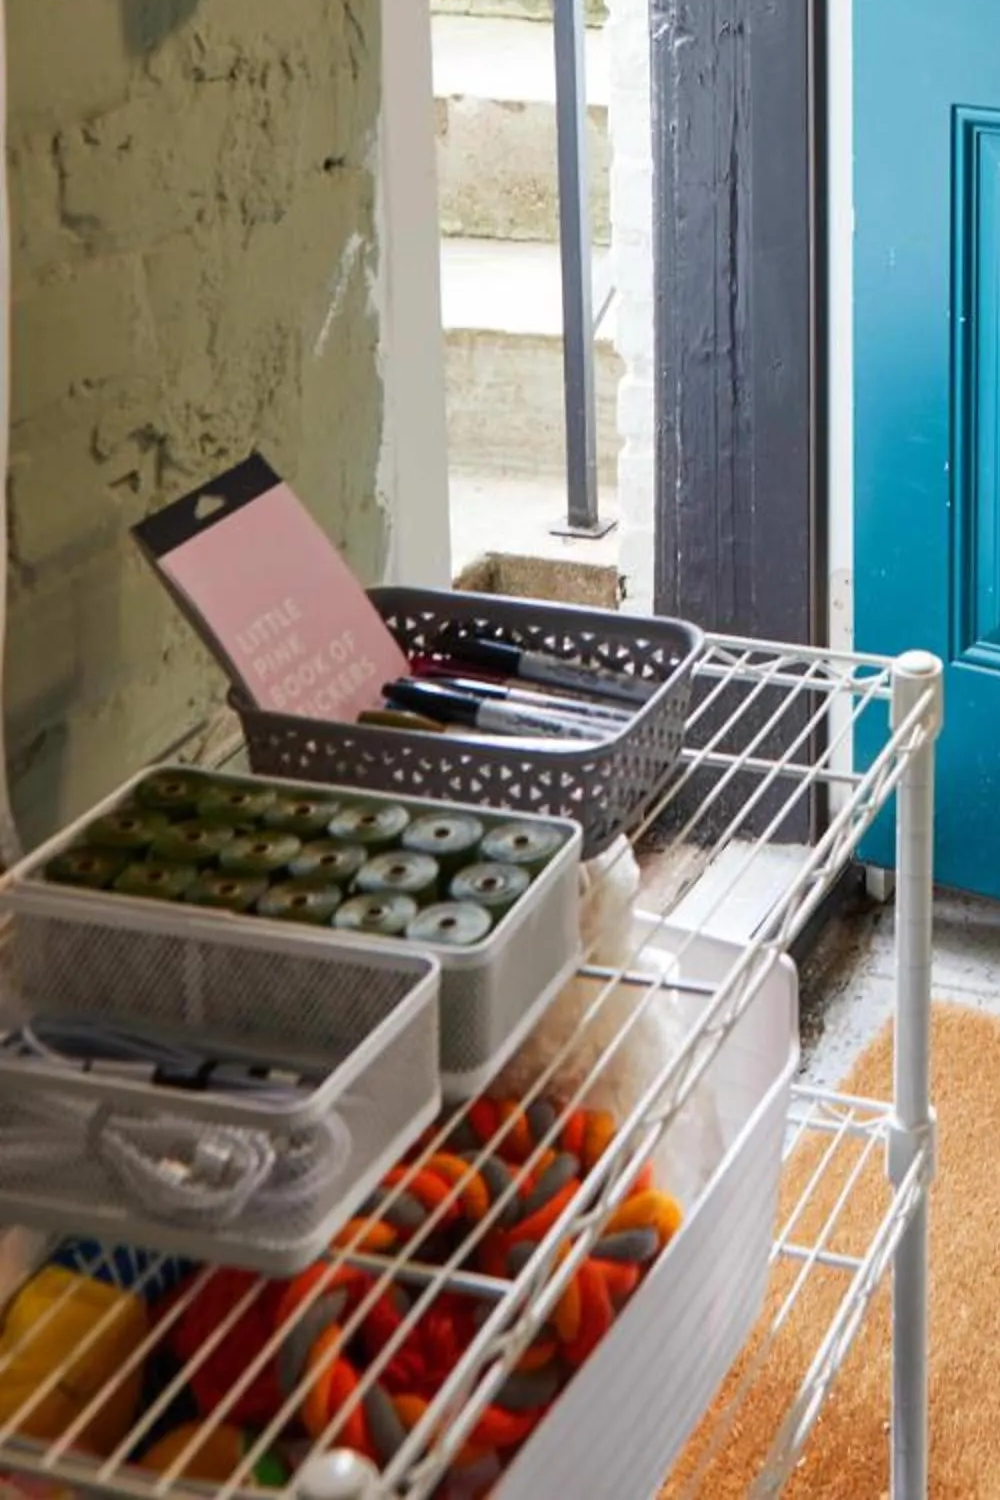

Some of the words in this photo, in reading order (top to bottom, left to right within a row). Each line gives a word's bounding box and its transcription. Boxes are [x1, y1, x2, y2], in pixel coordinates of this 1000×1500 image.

[235, 597, 302, 654] LITTLE
[252, 632, 306, 682] PINK
[269, 649, 331, 708] BOOK
[329, 630, 354, 663] OF
